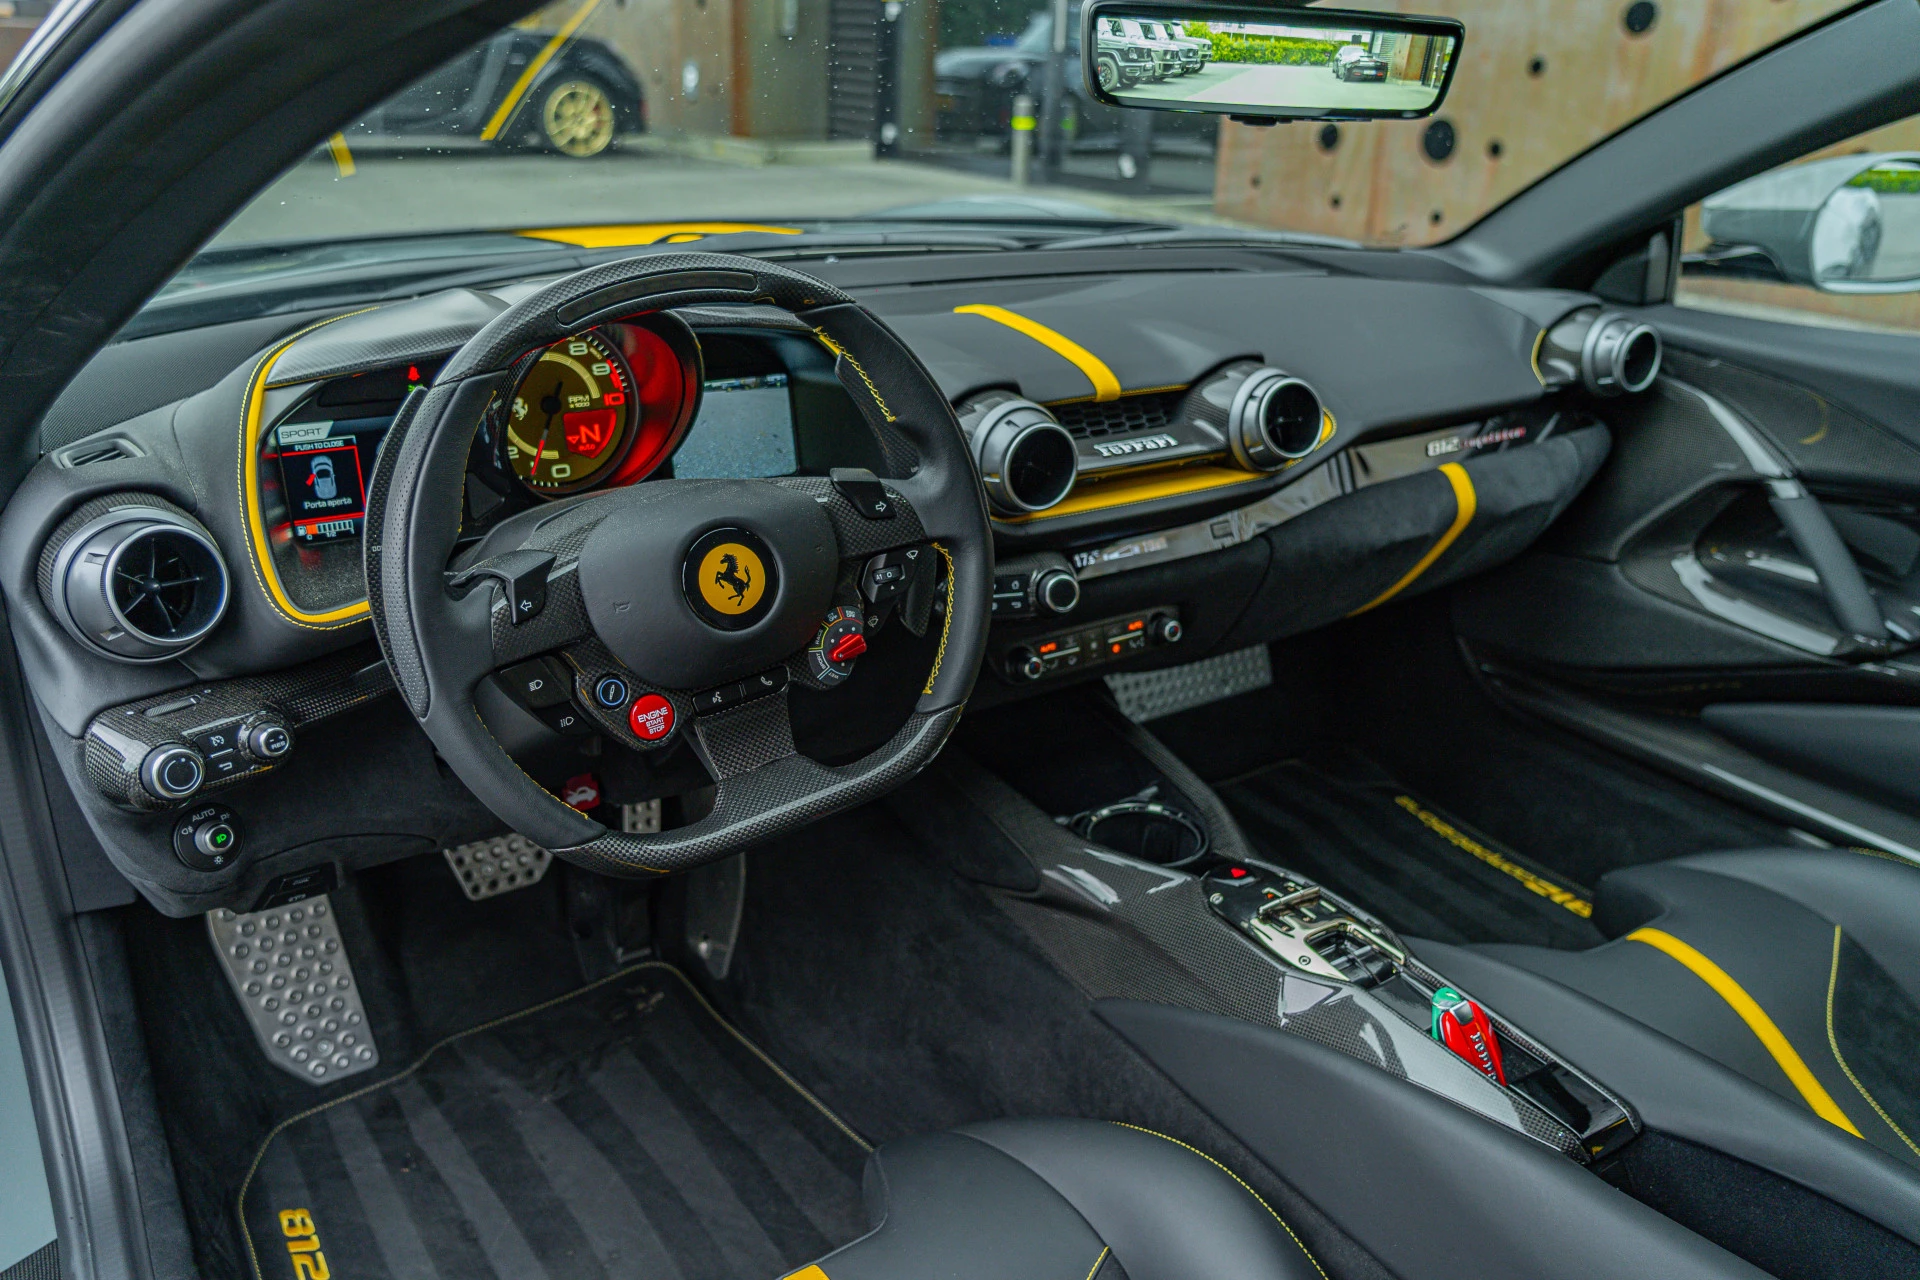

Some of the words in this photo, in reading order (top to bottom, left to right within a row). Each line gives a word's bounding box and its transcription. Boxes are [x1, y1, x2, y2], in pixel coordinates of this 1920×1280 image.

[568, 342, 588, 355] 8
[568, 395, 590, 403] RPM
[603, 393, 625, 406] 10
[281, 427, 322, 439] SPORT
[579, 423, 600, 443] N
[323, 440, 344, 448] CLOSE
[1094, 433, 1178, 457] Ferrari
[551, 464, 571, 478] 0
[304, 501, 327, 509] Porta
[327, 497, 352, 507] aperta
[816, 653, 826, 670] SPORT
[637, 706, 669, 723] ENGINE
[646, 716, 664, 727] START
[649, 724, 665, 735] STOP
[192, 808, 216, 822] AUTO
